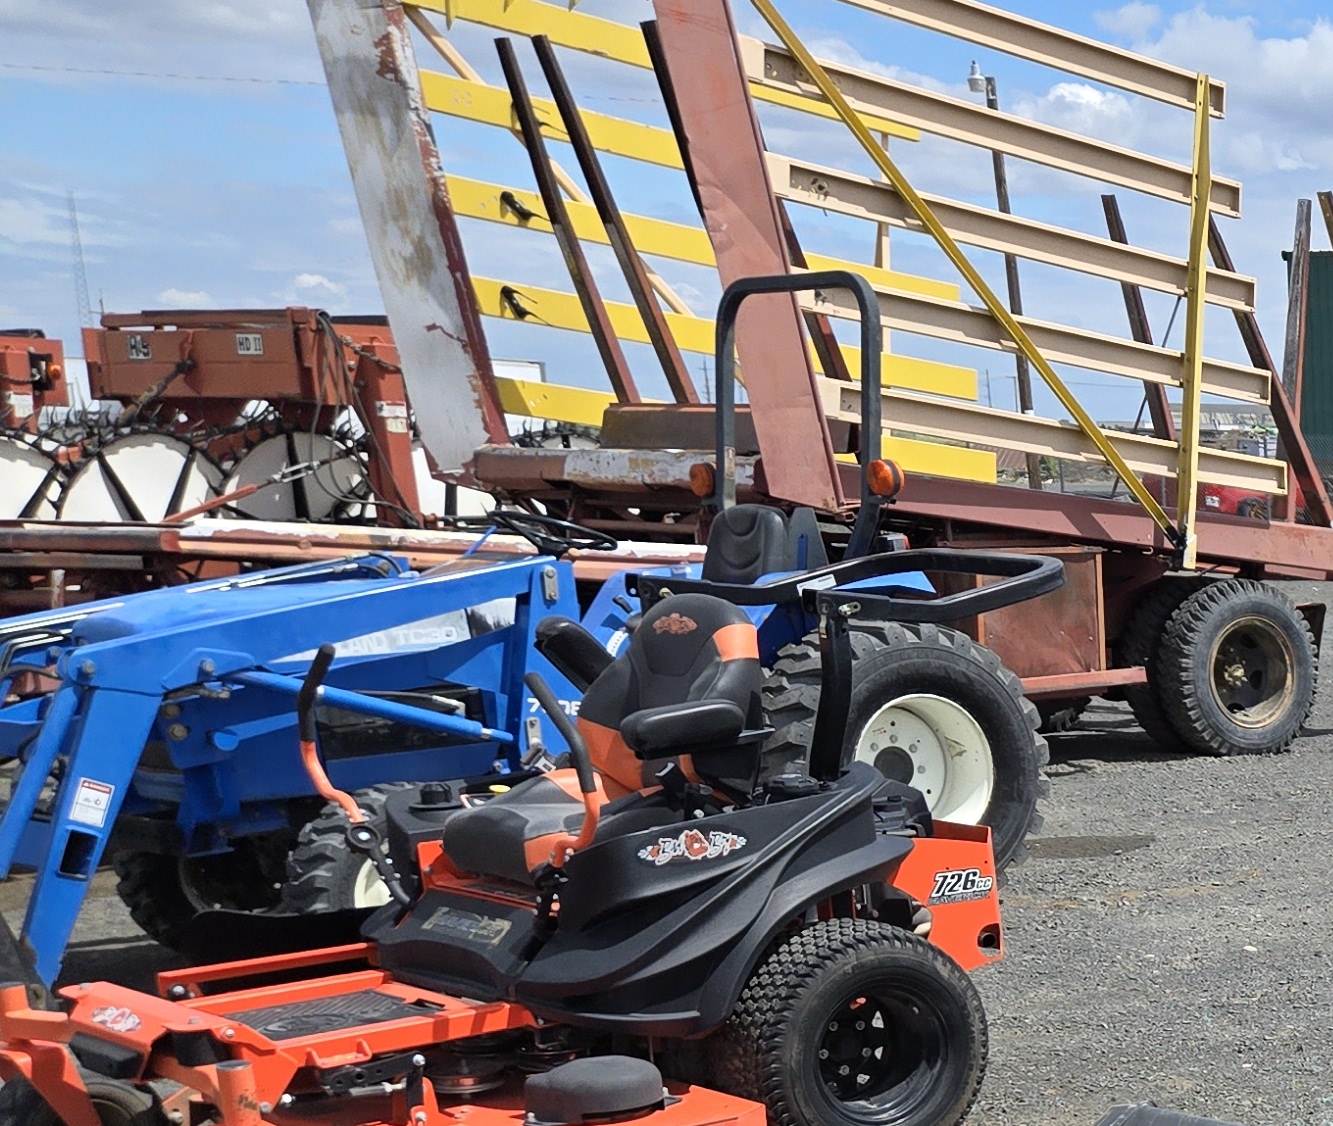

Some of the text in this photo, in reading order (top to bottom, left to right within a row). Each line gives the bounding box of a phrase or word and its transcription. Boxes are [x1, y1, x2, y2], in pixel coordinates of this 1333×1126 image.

[238, 336, 250, 351] HD
[336, 633, 387, 656] LAND
[931, 868, 993, 898] 726cc
